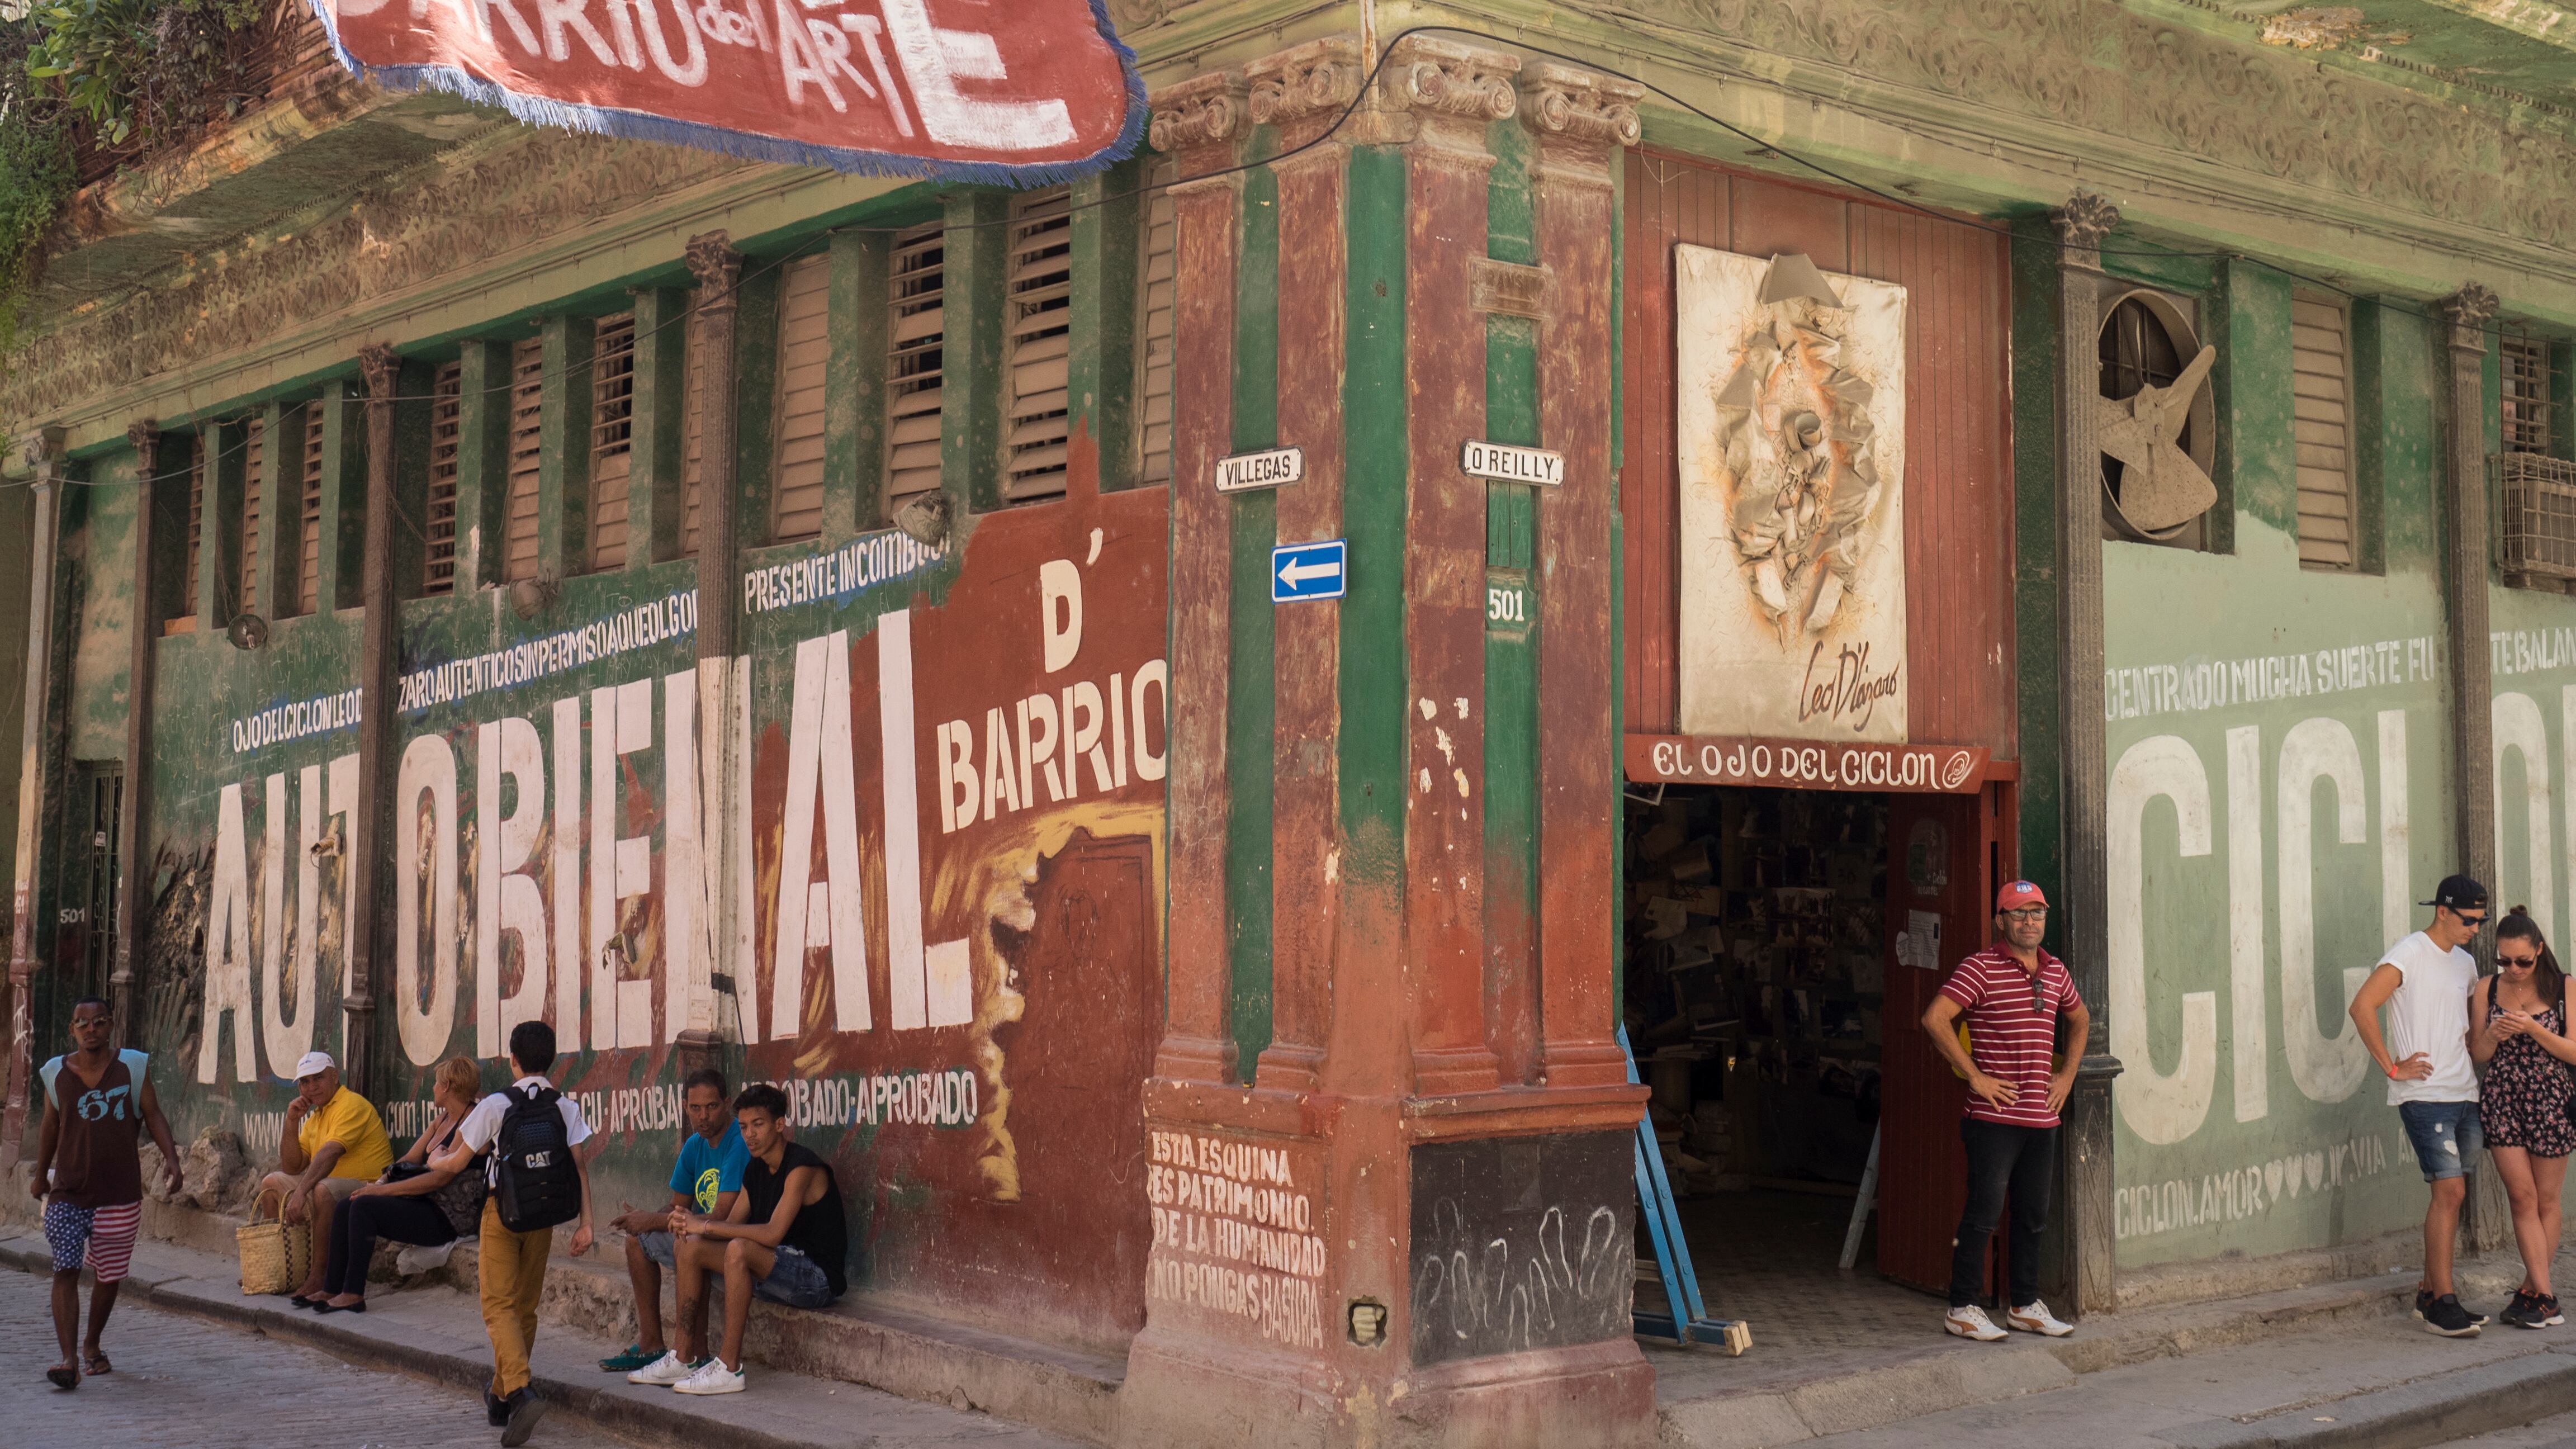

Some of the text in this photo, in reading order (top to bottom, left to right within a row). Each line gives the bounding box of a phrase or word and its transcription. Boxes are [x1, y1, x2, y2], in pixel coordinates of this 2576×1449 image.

[1225, 454, 1291, 486] VILLEGAS
[1489, 451, 1555, 481] REILLY
[745, 553, 836, 614] PRESENTE
[1487, 589, 1524, 622] 501
[2104, 661, 2227, 721] CENTRADO
[2231, 655, 2312, 703] MUCHA
[2316, 641, 2401, 694] SUERTE
[937, 659, 1167, 835] BARRIO
[1652, 741, 1941, 790] EL OJO DEL CICLON
[59, 907, 86, 924] 501
[77, 1085, 130, 1121] 67
[525, 1149, 552, 1169] CAT
[1152, 1131, 1294, 1187] ESTA ESQUINA
[1152, 1164, 1175, 1204] ES
[1153, 1207, 1326, 1278] DE LA HUMANIDAD
[1153, 1257, 1324, 1349] NO PONGAS BASURA
